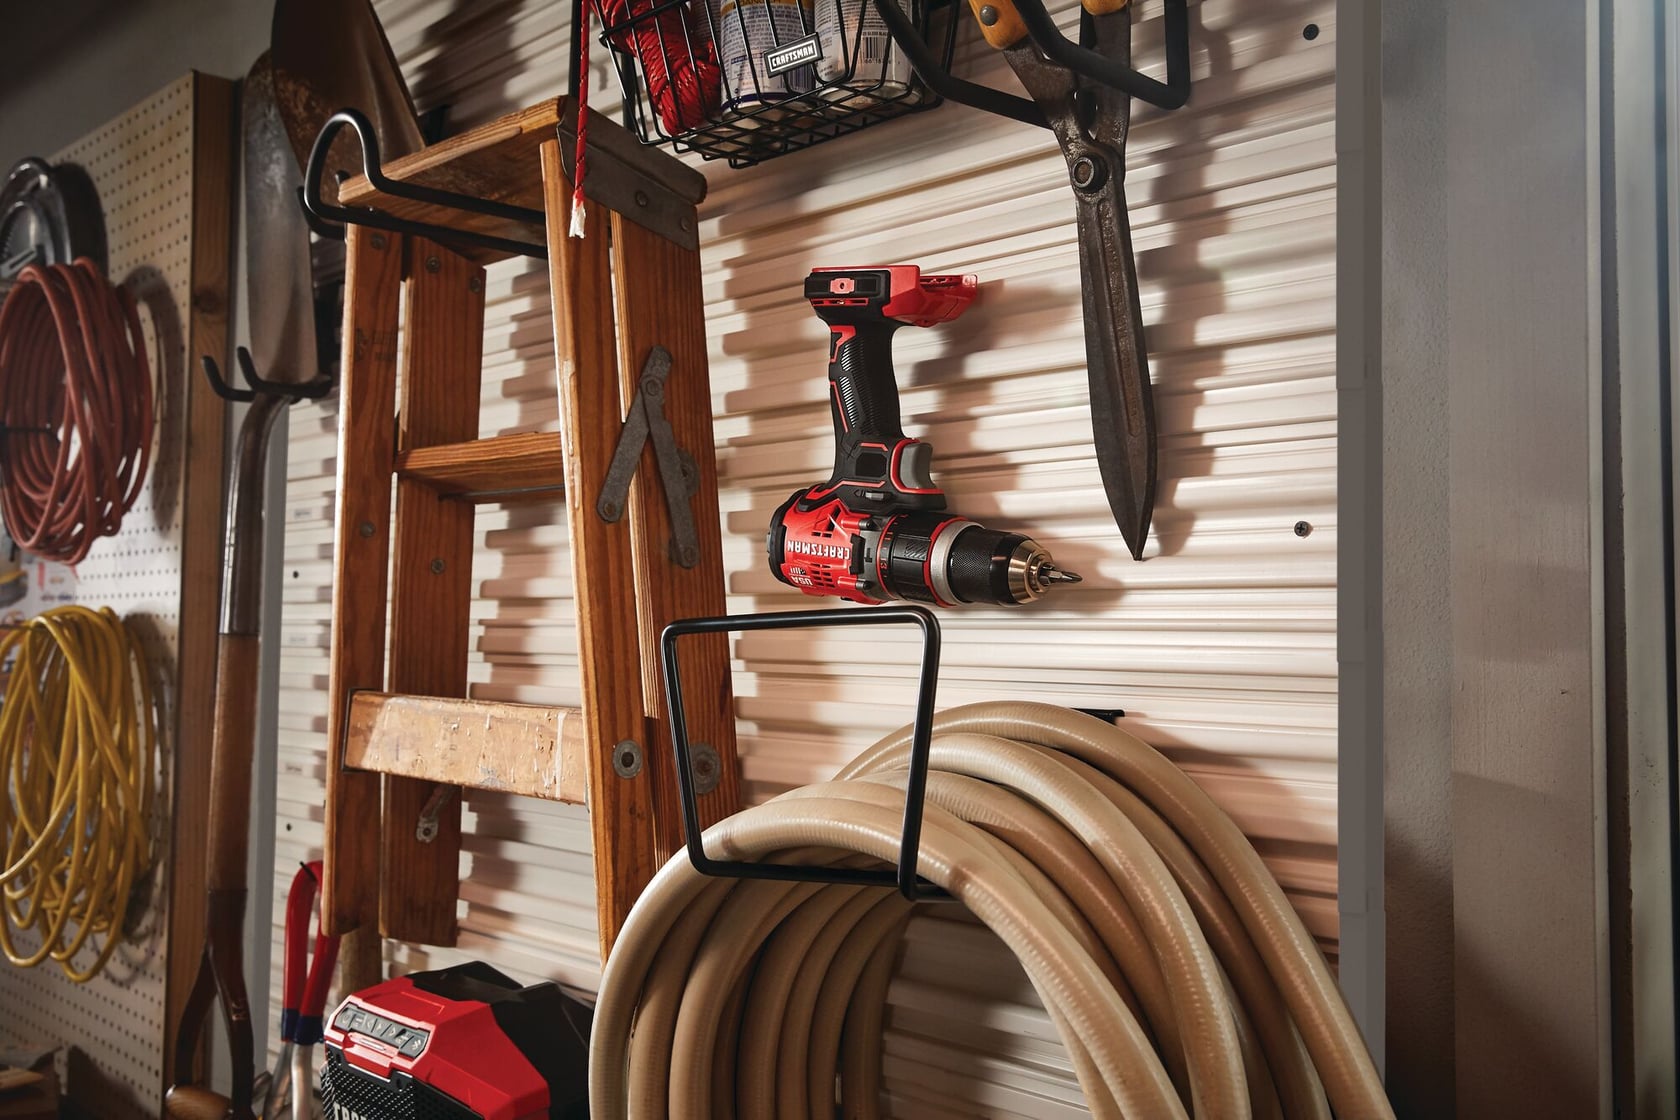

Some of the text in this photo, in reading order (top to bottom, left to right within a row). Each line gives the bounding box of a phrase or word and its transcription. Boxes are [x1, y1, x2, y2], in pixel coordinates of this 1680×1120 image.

[771, 44, 814, 67] CRAFTSMAN
[787, 541, 850, 560] CRAFTSMAN
[791, 576, 813, 586] USA
